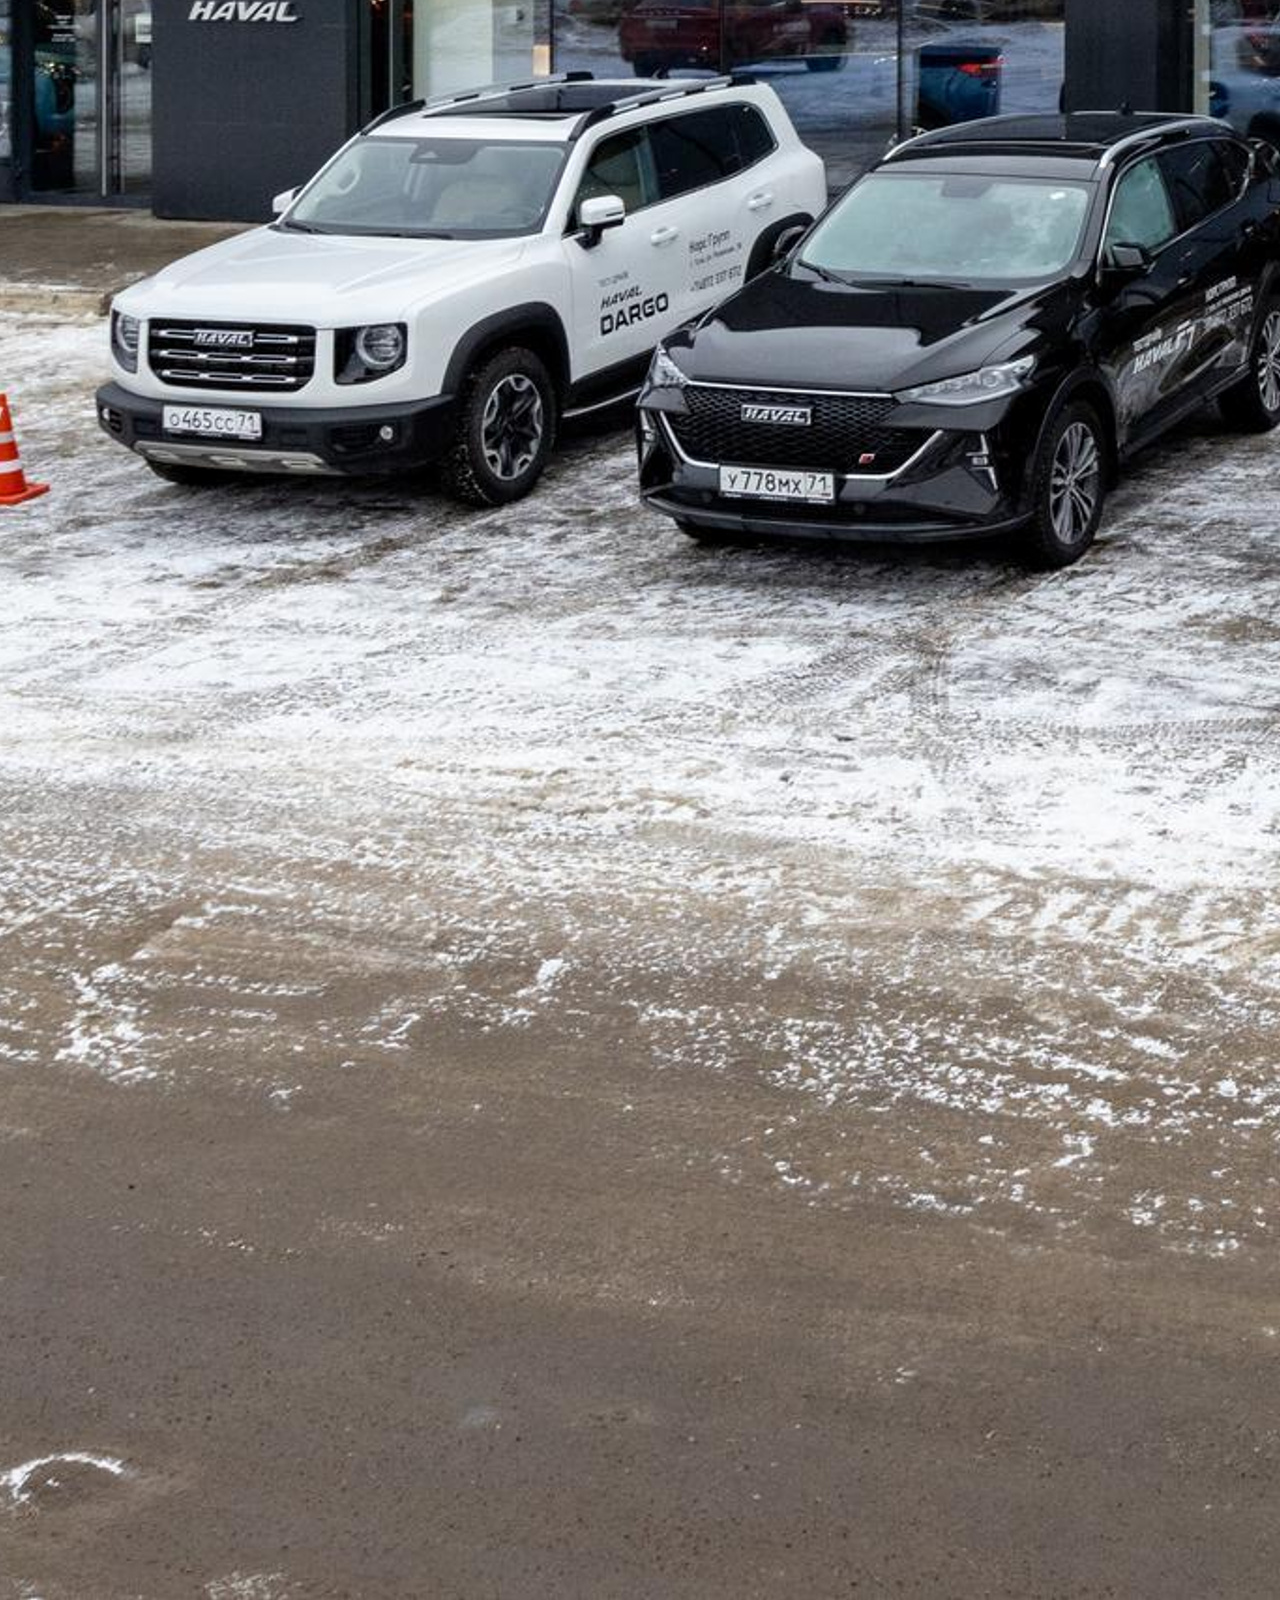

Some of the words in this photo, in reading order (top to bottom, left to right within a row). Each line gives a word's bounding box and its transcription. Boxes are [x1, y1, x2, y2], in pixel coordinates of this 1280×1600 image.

[188, 1, 298, 22] HAVAL
[601, 285, 643, 311] HAVAL
[600, 292, 669, 336] DARGO
[196, 332, 252, 346] HAVAL
[745, 407, 808, 423] HAVAL
